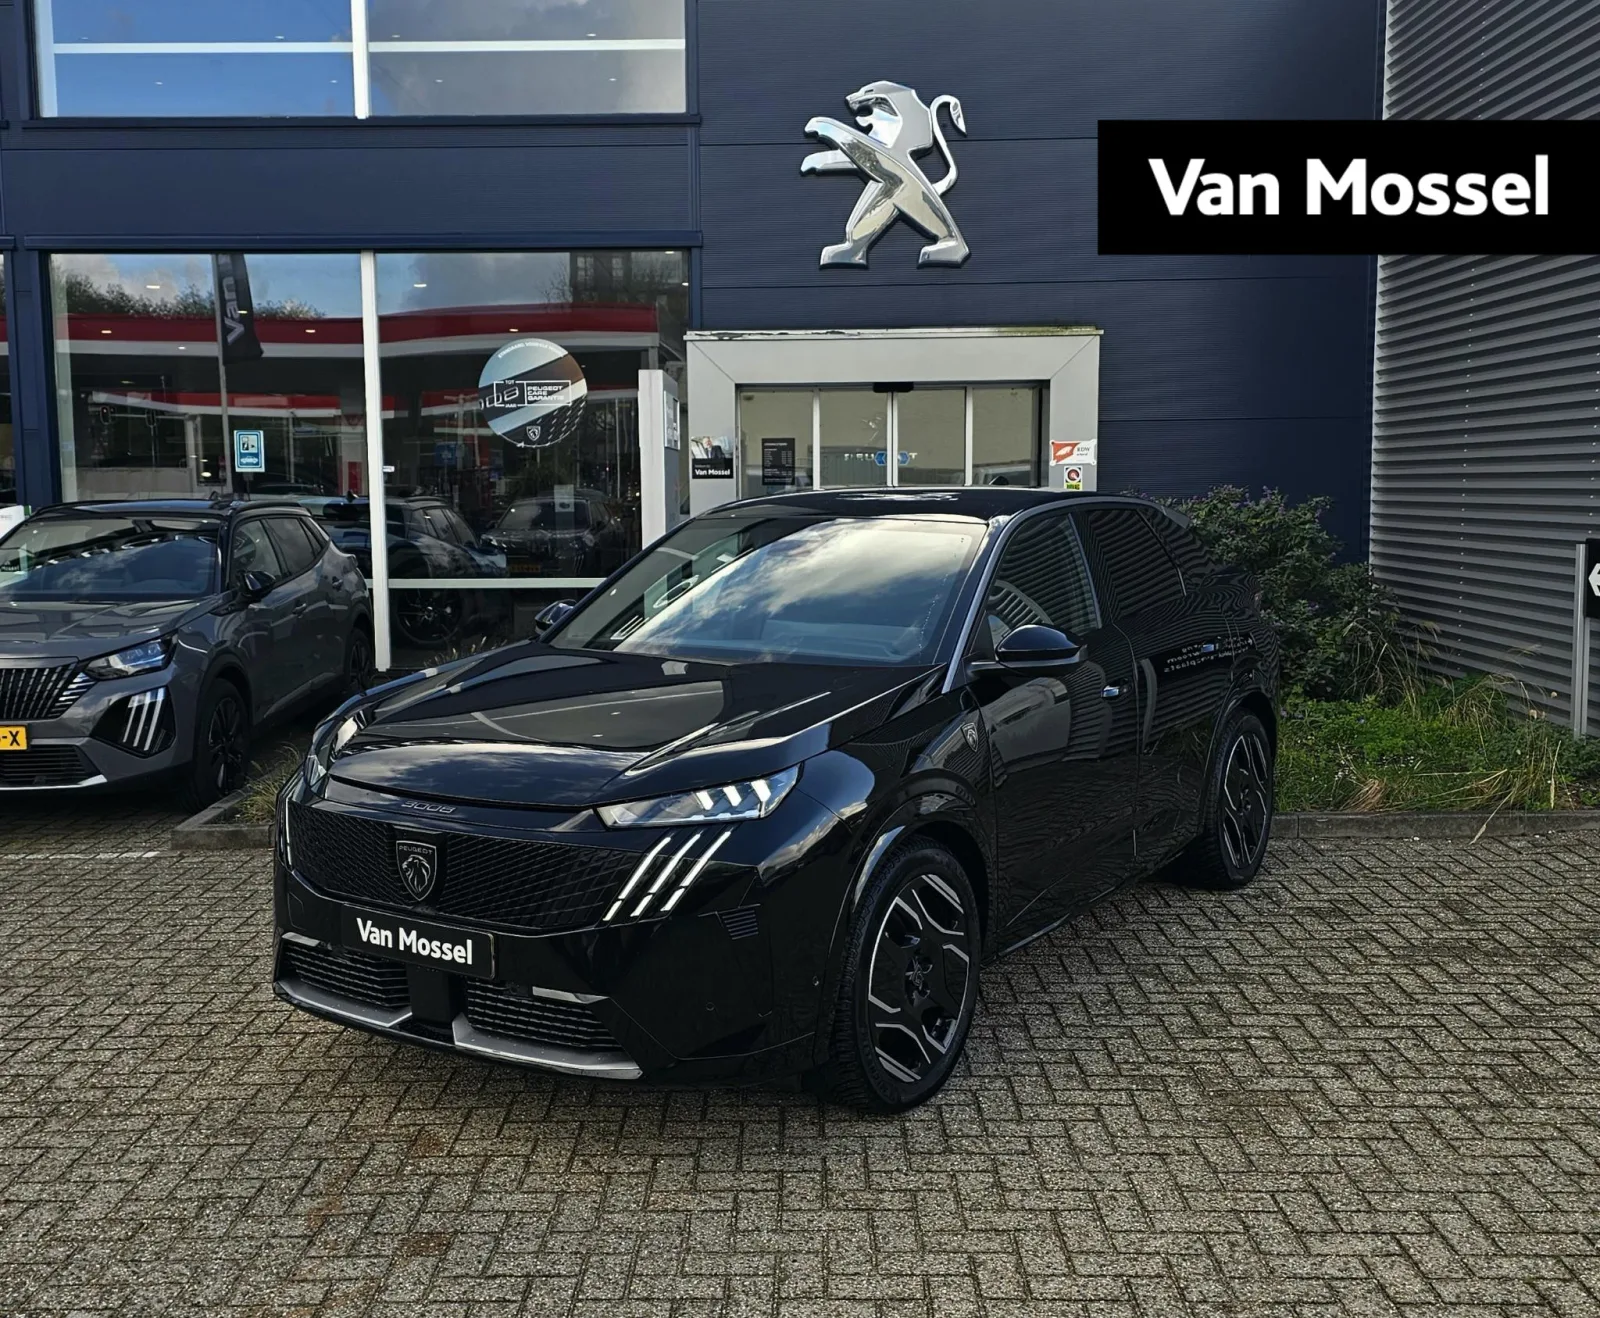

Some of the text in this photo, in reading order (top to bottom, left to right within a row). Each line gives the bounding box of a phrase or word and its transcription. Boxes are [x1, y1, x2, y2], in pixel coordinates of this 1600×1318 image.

[222, 276, 245, 345] Van
[695, 468, 731, 476] Van Mossel
[401, 800, 456, 813] 3008
[398, 845, 433, 855] PEUGEOT
[356, 917, 473, 965] Van Mossel
